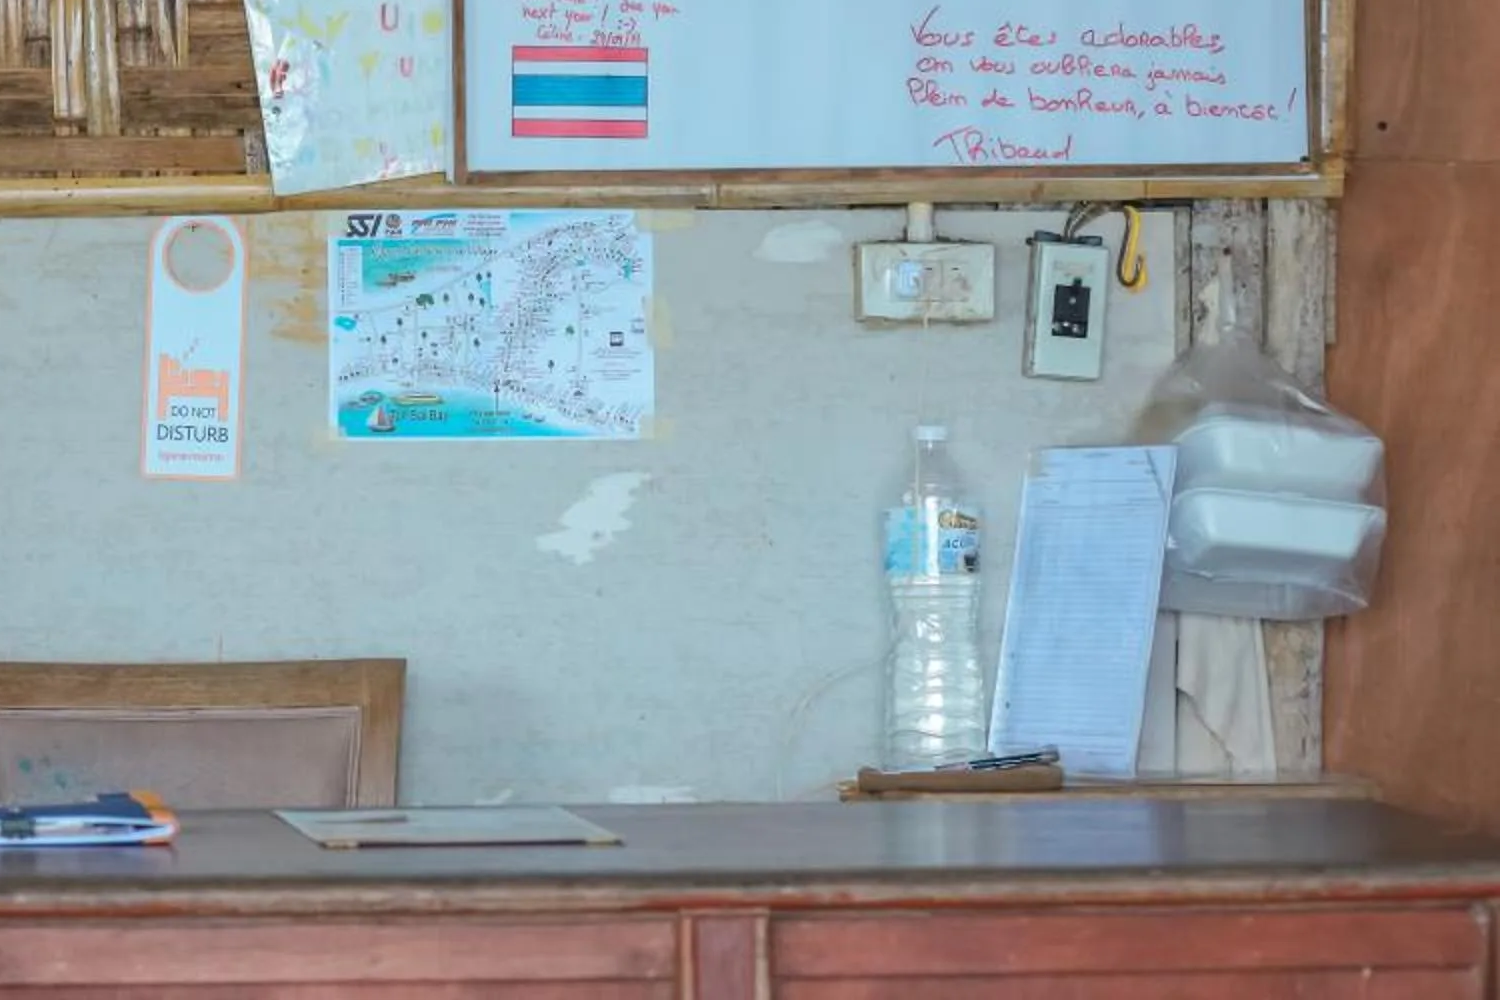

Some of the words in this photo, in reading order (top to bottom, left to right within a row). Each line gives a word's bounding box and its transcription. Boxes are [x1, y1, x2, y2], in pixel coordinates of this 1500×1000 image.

[522, 1, 557, 20] next
[910, 5, 975, 47] Vous
[994, 21, 1057, 47] êtes
[969, 55, 1015, 75] vous
[1145, 59, 1228, 91] jamais
[906, 77, 969, 106] Plein
[980, 88, 1016, 109] de
[1152, 89, 1173, 116] à
[171, 405, 189, 418] DO
[191, 406, 216, 419] NOT
[156, 423, 230, 443] DISTURB
